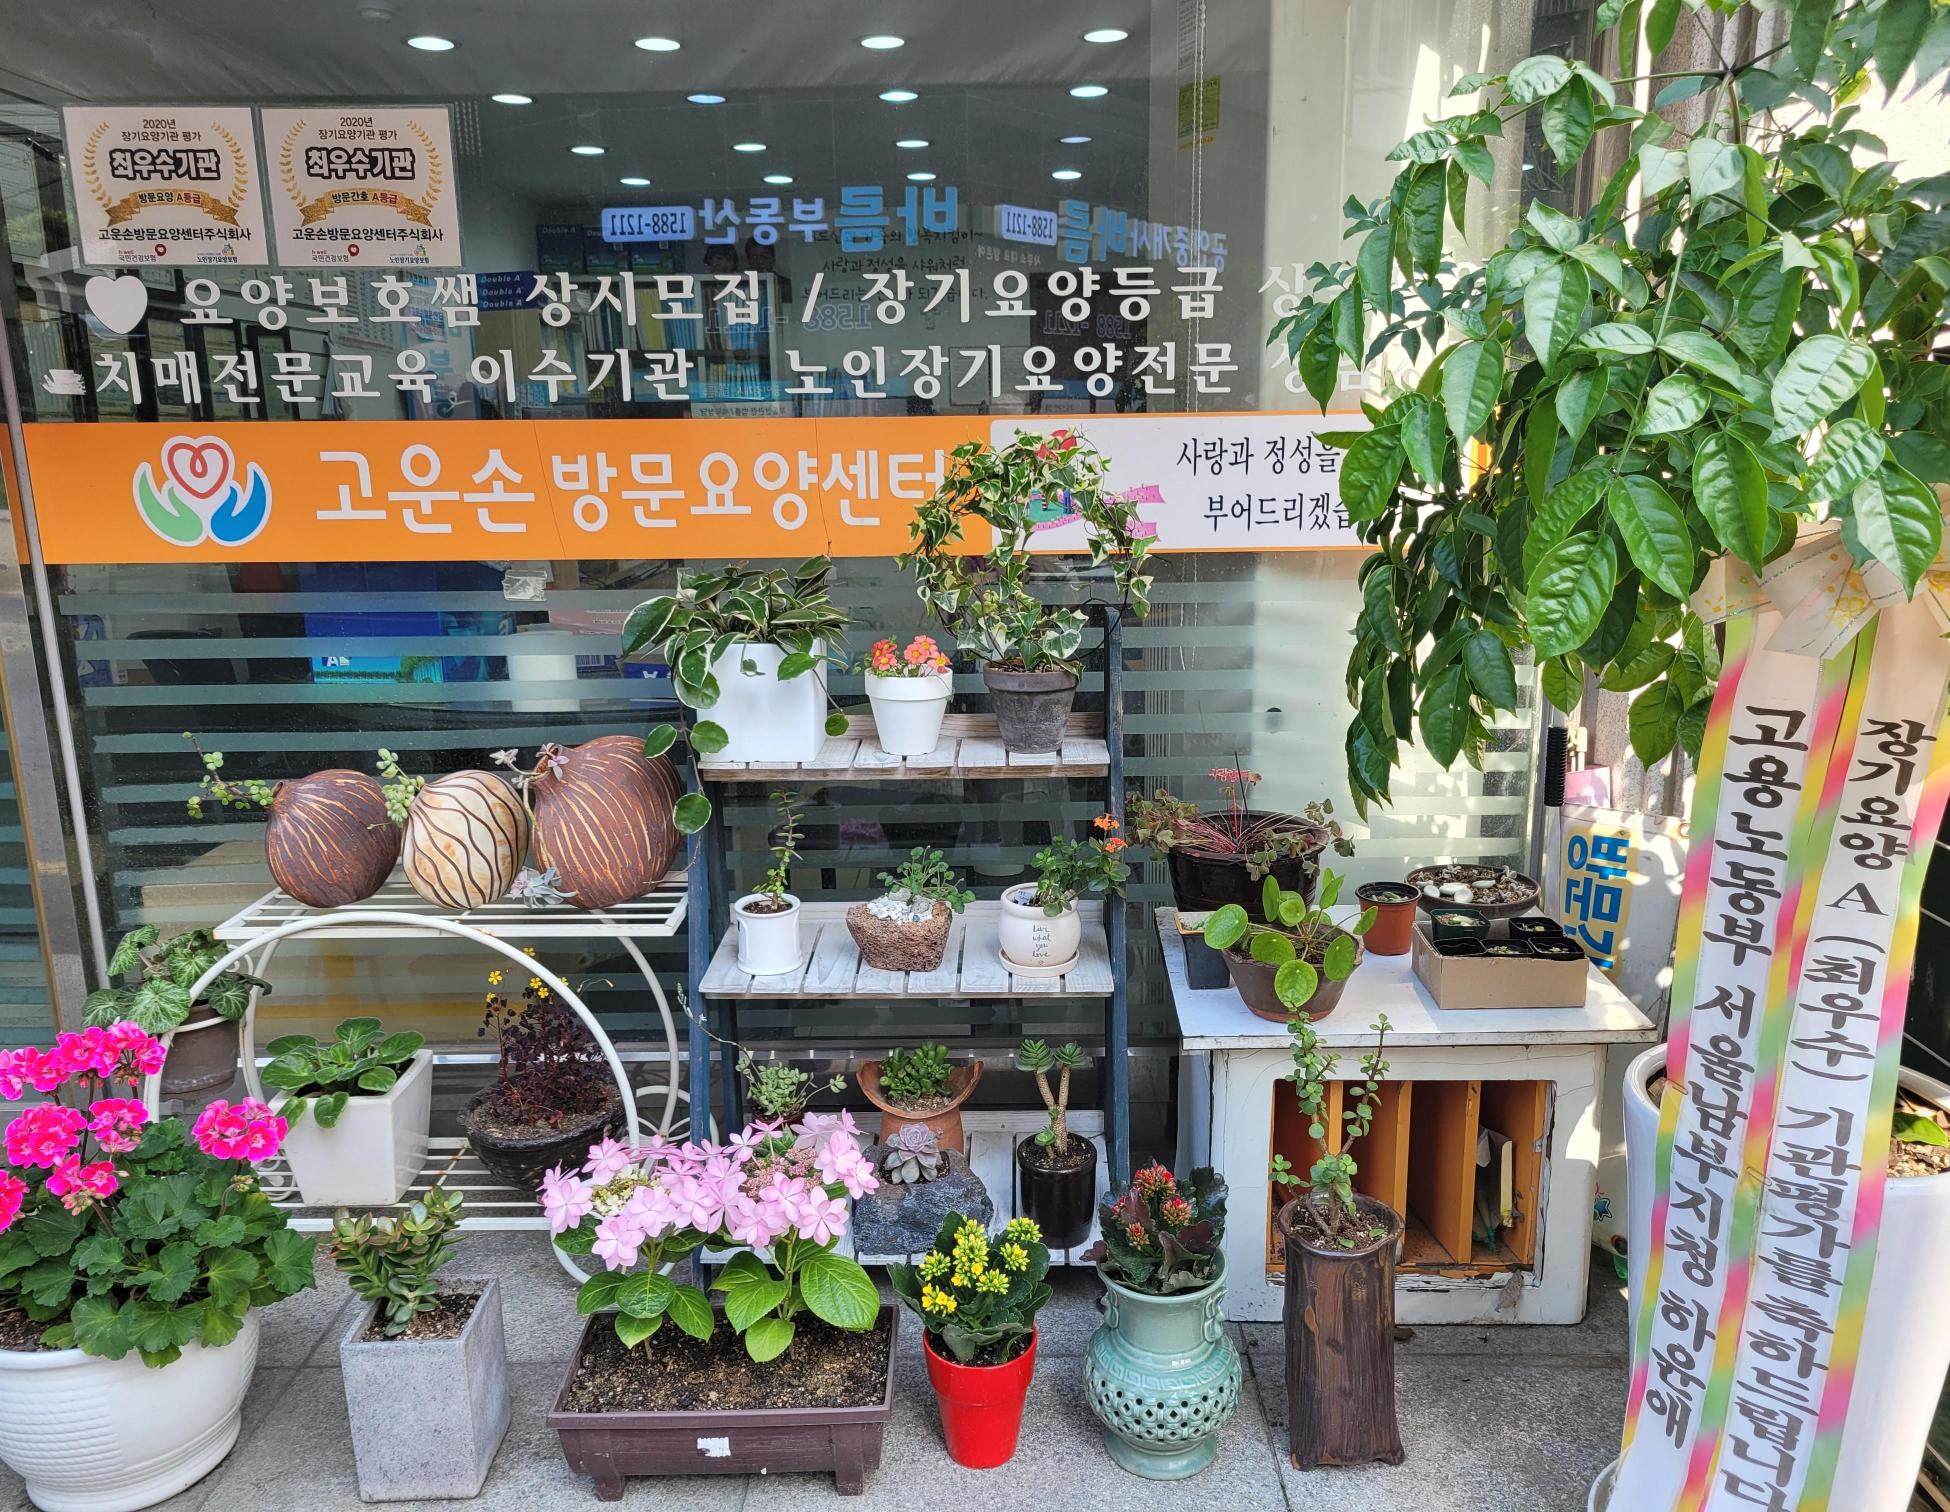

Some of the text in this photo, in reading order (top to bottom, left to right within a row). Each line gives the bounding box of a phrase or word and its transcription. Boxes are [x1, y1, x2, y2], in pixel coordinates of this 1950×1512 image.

[121, 131, 202, 142] 장기요양기관 평가
[142, 119, 177, 130] 2020년
[318, 129, 397, 141] 장기요양기관 평가
[340, 117, 373, 127] 2020년
[110, 149, 220, 180] 최우수기관
[306, 148, 415, 180] 최우수기관
[138, 192, 201, 205] 방문요양 A등급
[332, 192, 398, 205] 방문간호 A등급
[98, 228, 251, 241] 고운손방문요양센터주식회사
[292, 228, 443, 242] 고운손방문요양센터주식회사
[180, 273, 481, 330] 요양보호쌤
[526, 271, 759, 327] 상시모집
[860, 266, 1223, 325] 장기요양등급
[96, 350, 437, 404] 치매전문교육
[470, 348, 694, 403] 이수기관
[785, 343, 1240, 399] 노인장기요양전문
[1176, 435, 1341, 477] 사랑과 정성을
[1839, 719, 1937, 870] 장기요양
[1703, 705, 1809, 967] 고용노동부
[1790, 935, 1886, 1082] (최우수)
[1666, 984, 1757, 1288] 서울남부지청
